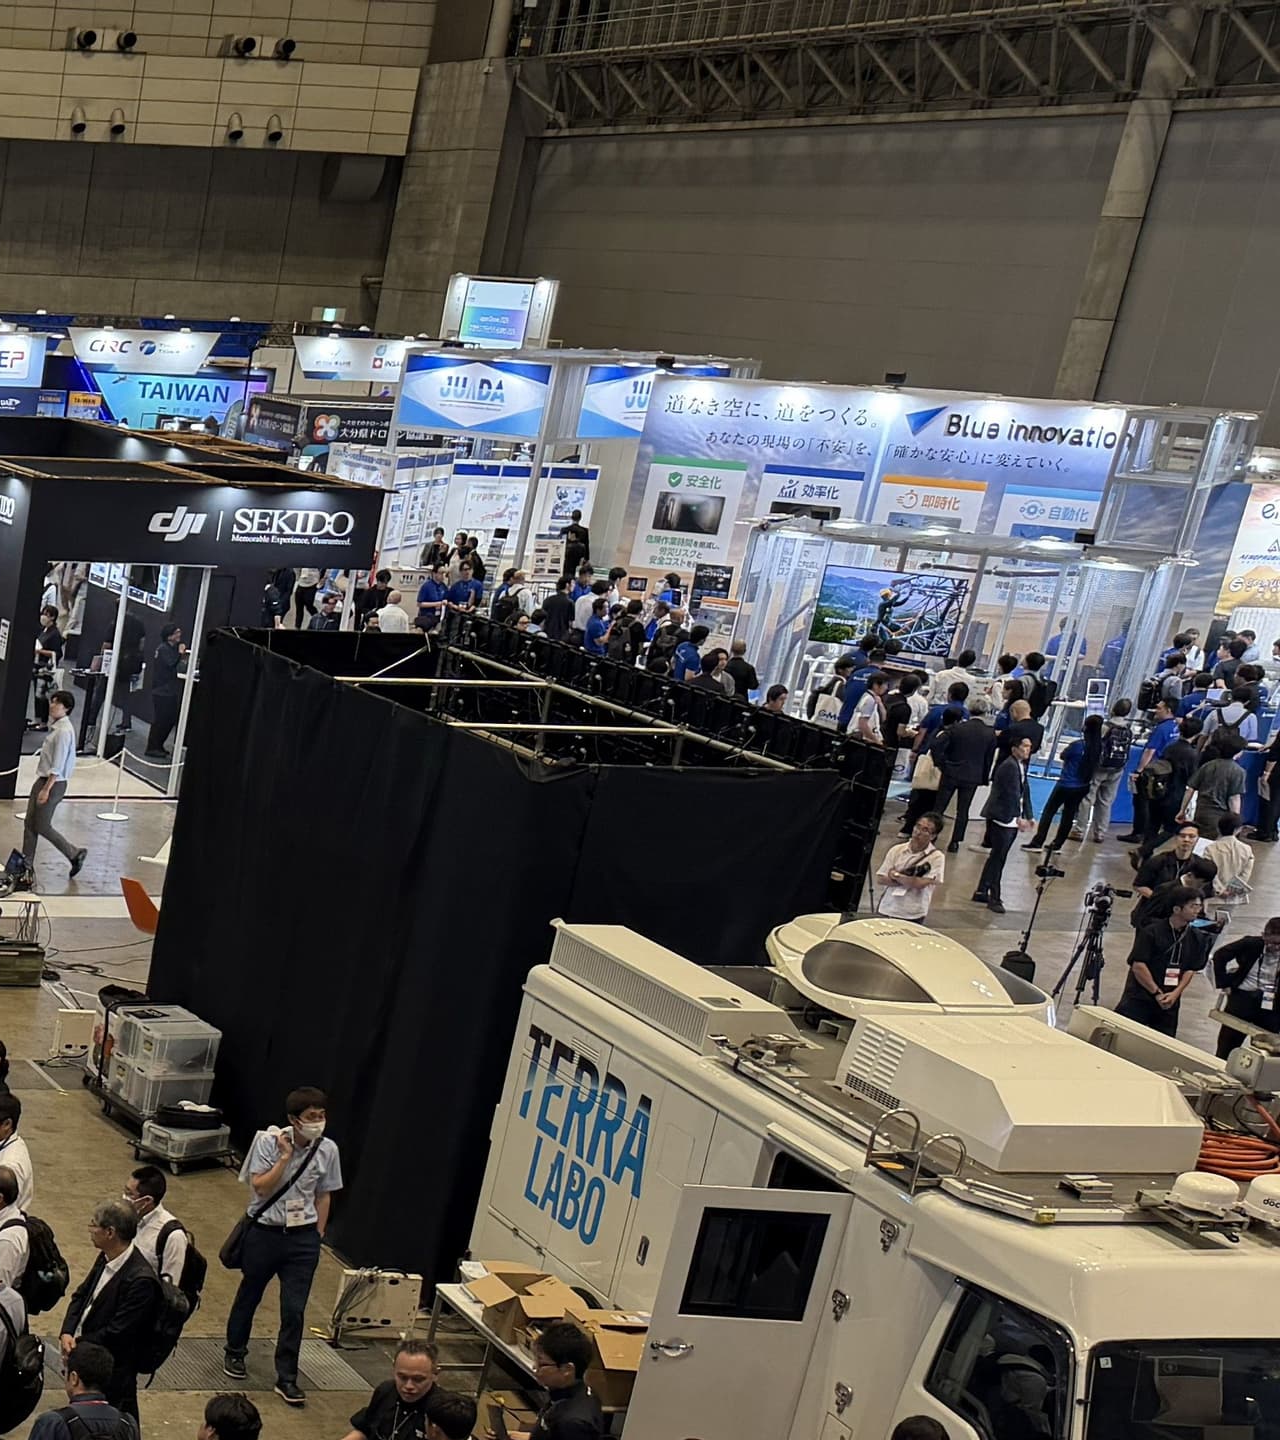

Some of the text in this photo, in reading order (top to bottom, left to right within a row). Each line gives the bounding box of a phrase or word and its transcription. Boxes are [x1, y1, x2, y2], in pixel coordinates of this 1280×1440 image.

[138, 380, 231, 404] TAIWAN
[664, 393, 879, 429] 道なき空に、道をつくる。
[338, 428, 434, 442] 大分県ドロン協議会
[943, 412, 1000, 440] Blue
[704, 431, 873, 457] あなたの現場の「不安」を、
[685, 474, 722, 491] 安全化
[800, 483, 840, 500] 効率化
[920, 495, 960, 512] 即時化
[1047, 505, 1090, 523] 自動化
[147, 505, 355, 542] dji SEKIDO
[231, 533, 270, 544] Memorable
[271, 535, 310, 547] Experience,
[648, 555, 699, 569] 安全コストを
[518, 1023, 653, 1200] TERRA
[523, 1134, 606, 1246] LABO
